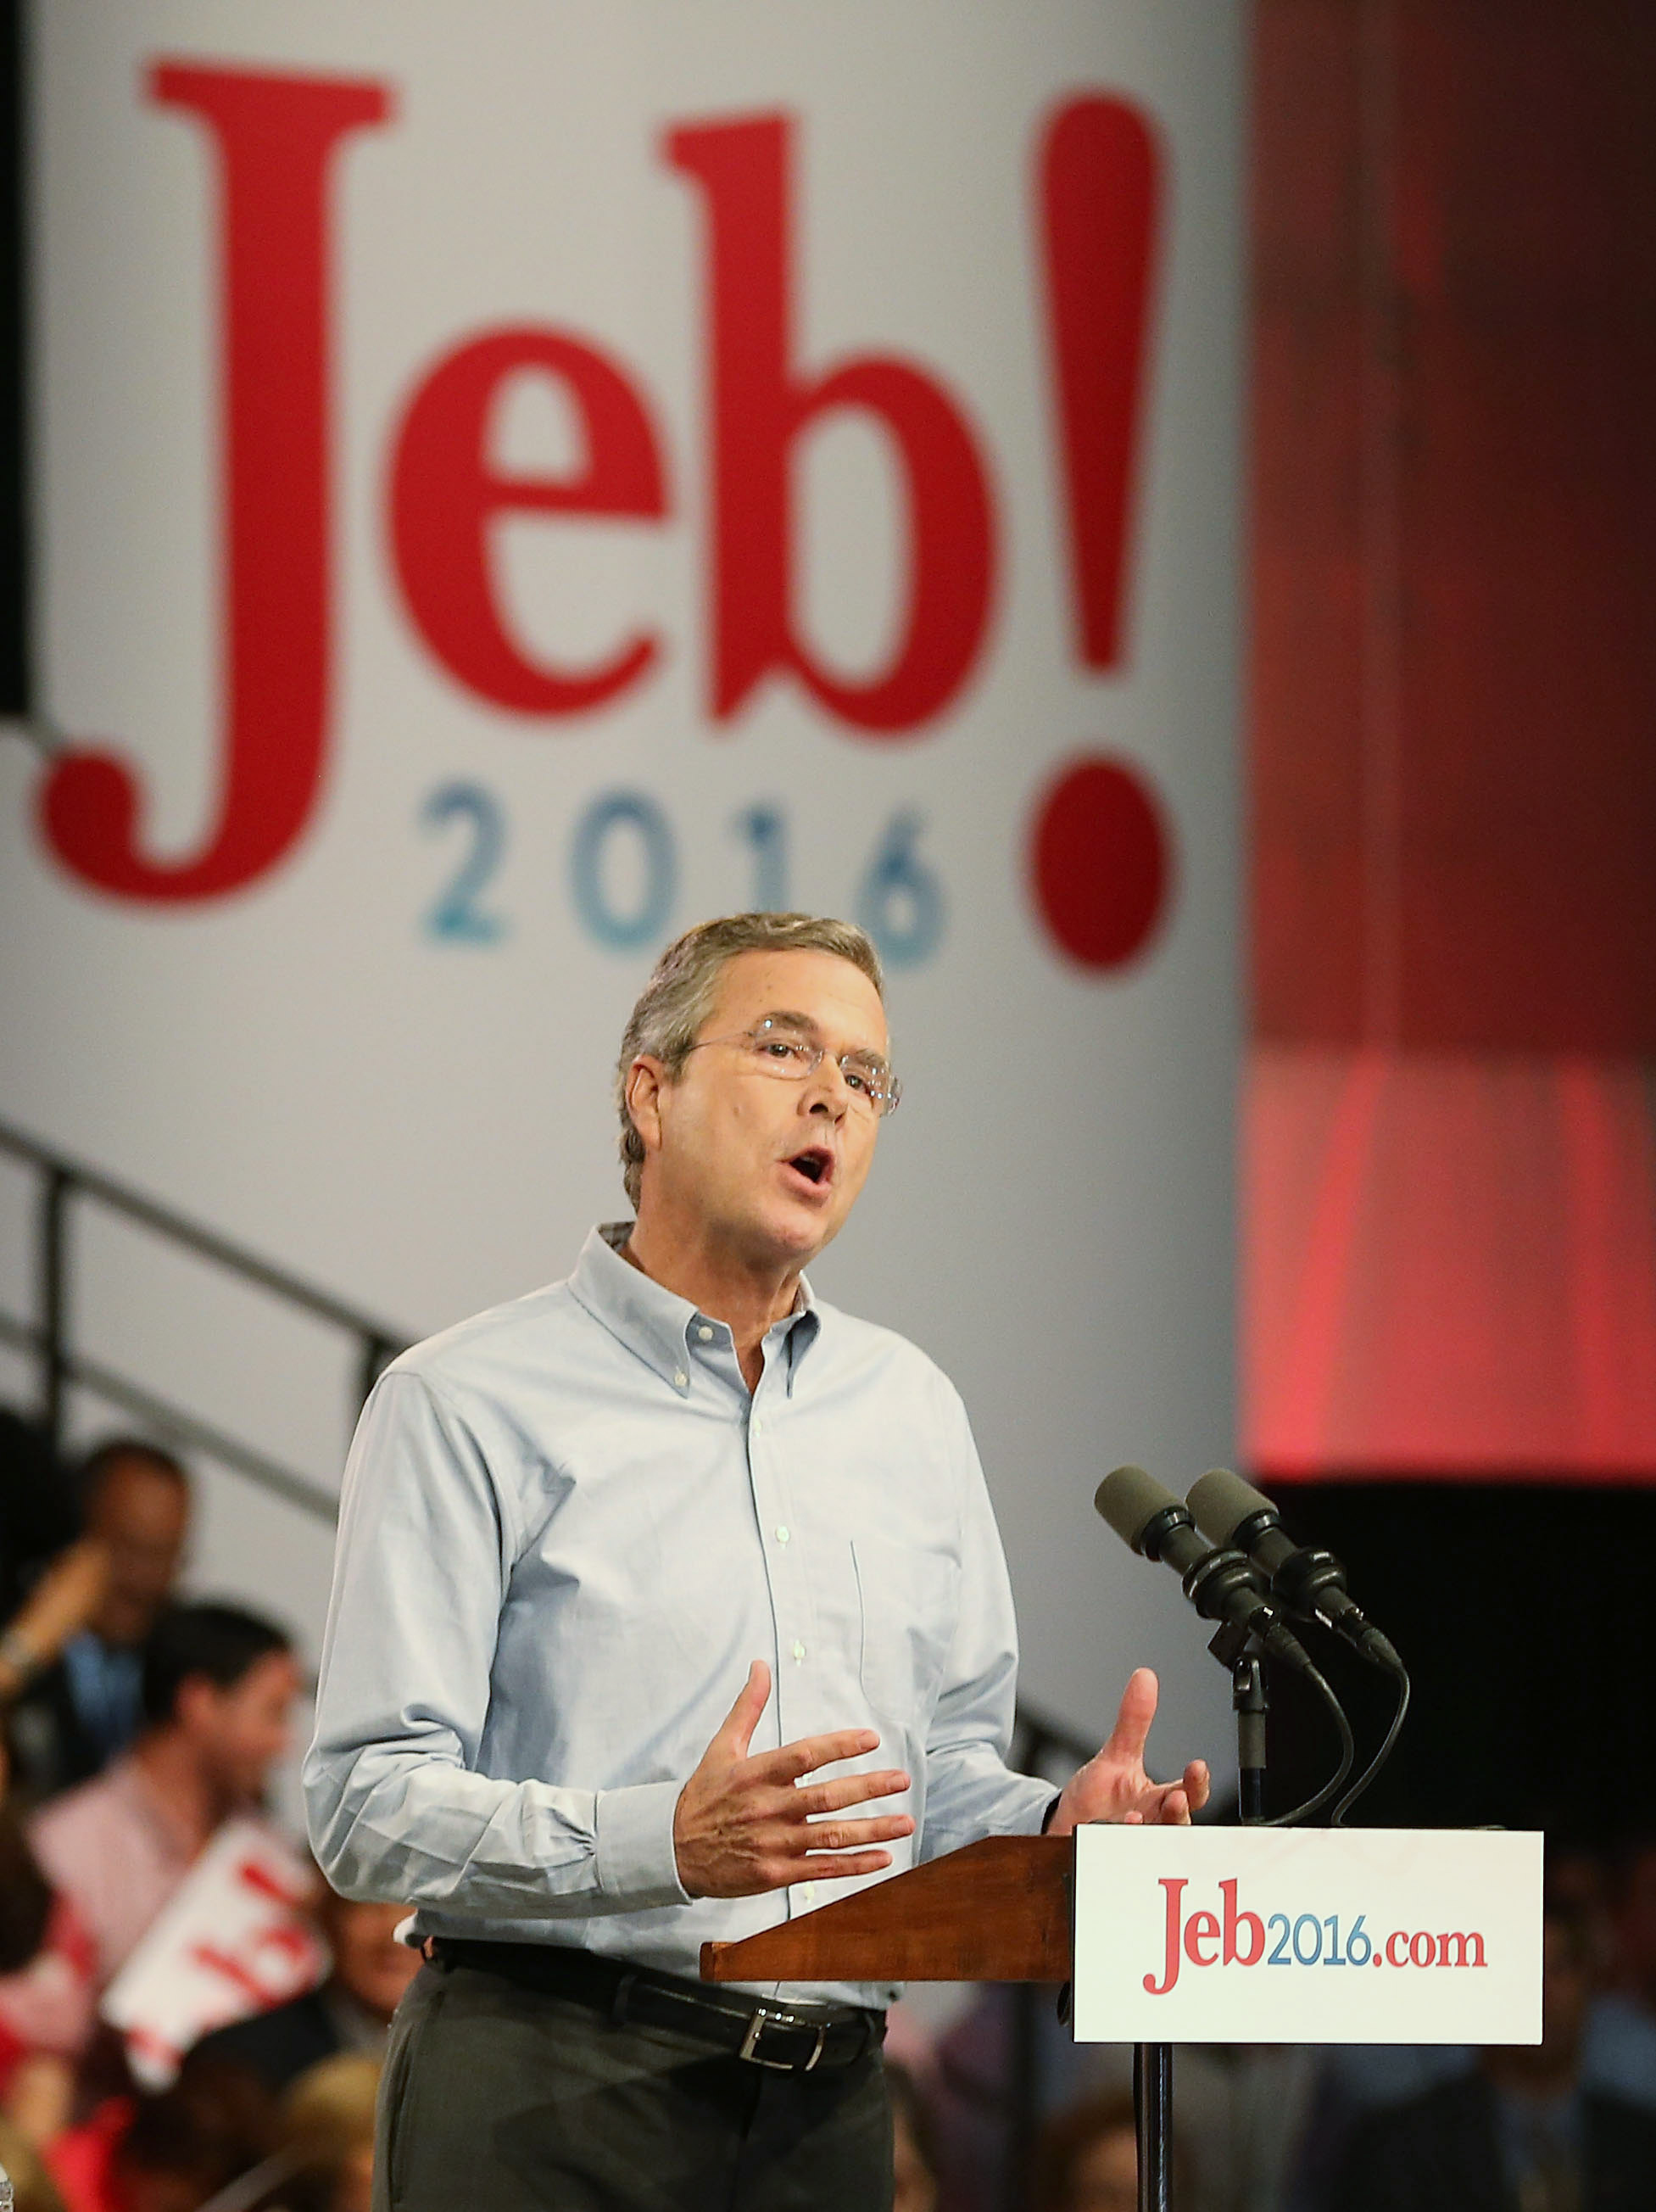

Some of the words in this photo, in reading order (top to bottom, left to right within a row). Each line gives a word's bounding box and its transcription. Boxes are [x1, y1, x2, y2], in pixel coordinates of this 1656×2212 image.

[38, 59, 1170, 977] Jeb!
[421, 780, 947, 970] 2016
[1142, 1877, 1488, 1996] Jeb2016.com
